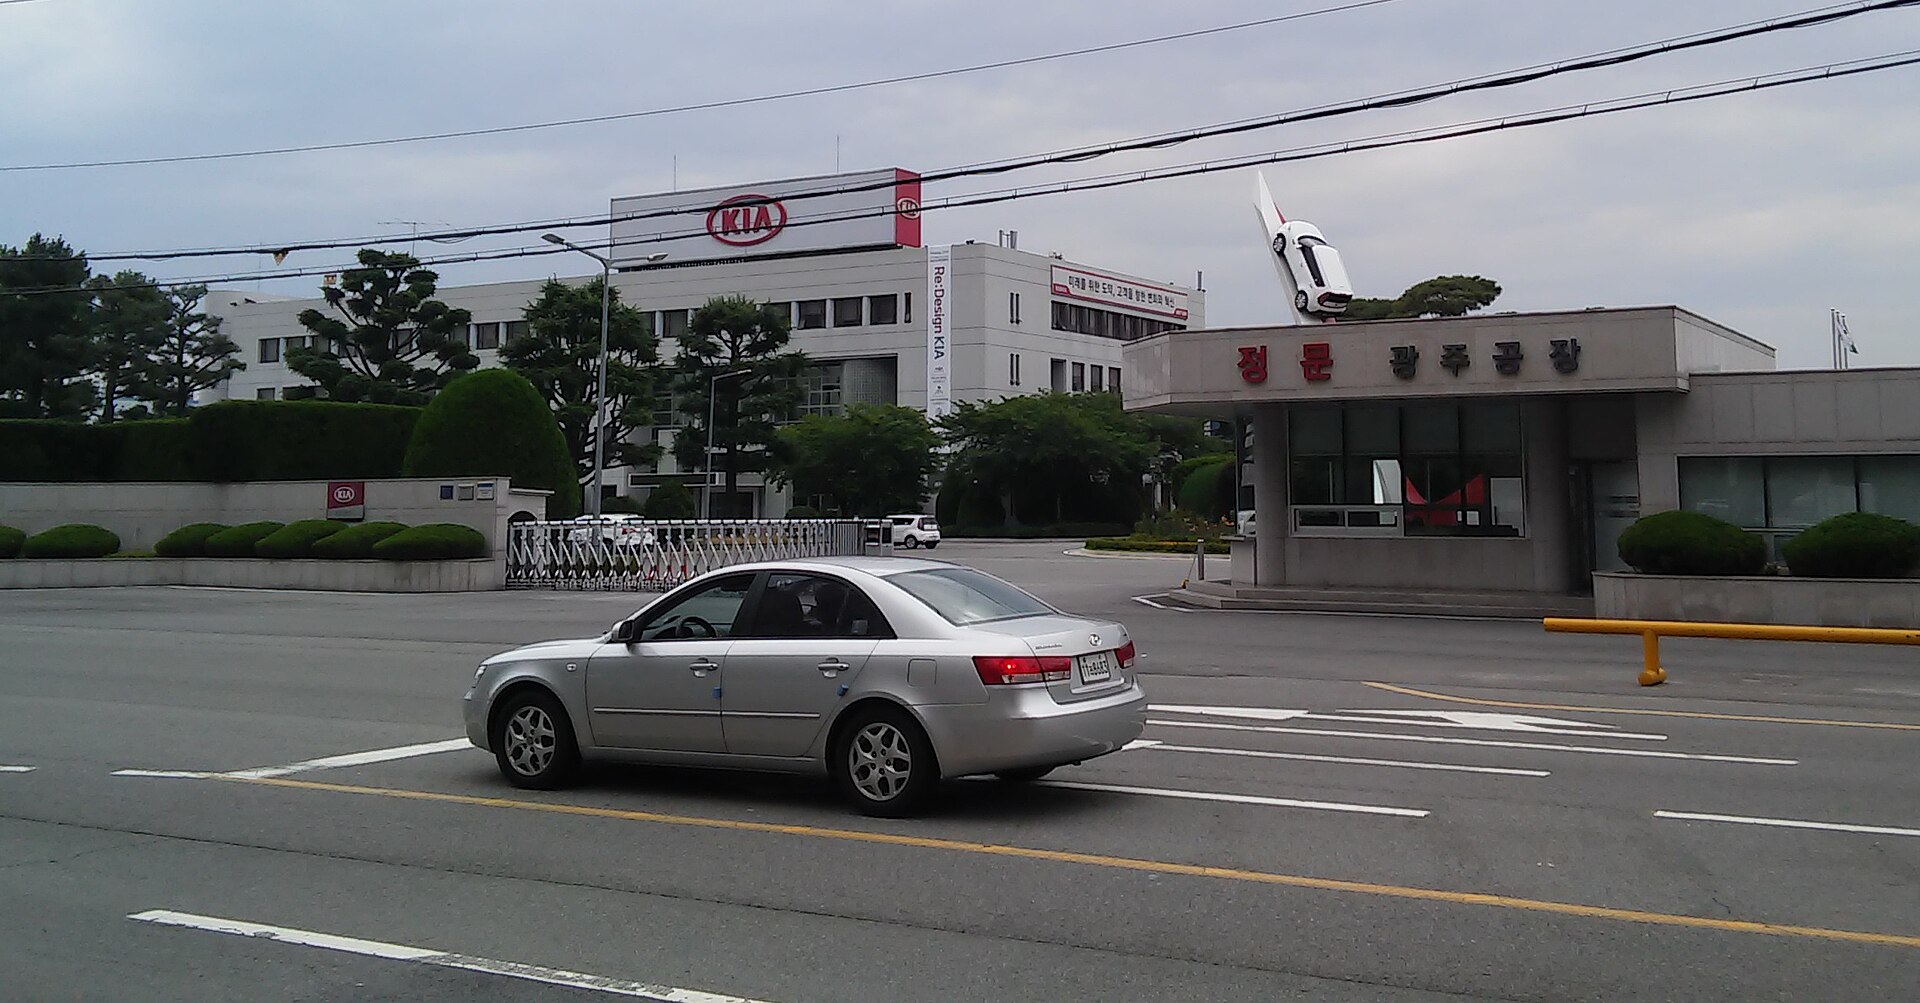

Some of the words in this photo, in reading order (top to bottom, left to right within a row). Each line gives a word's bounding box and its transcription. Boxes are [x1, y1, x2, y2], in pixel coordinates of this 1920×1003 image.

[721, 205, 773, 236] KIA
[932, 266, 945, 334] Re:Design
[1068, 275, 1086, 291] 미래를
[1088, 279, 1100, 294] 위한
[1116, 285, 1133, 300] 고객을
[934, 336, 945, 360] KIA
